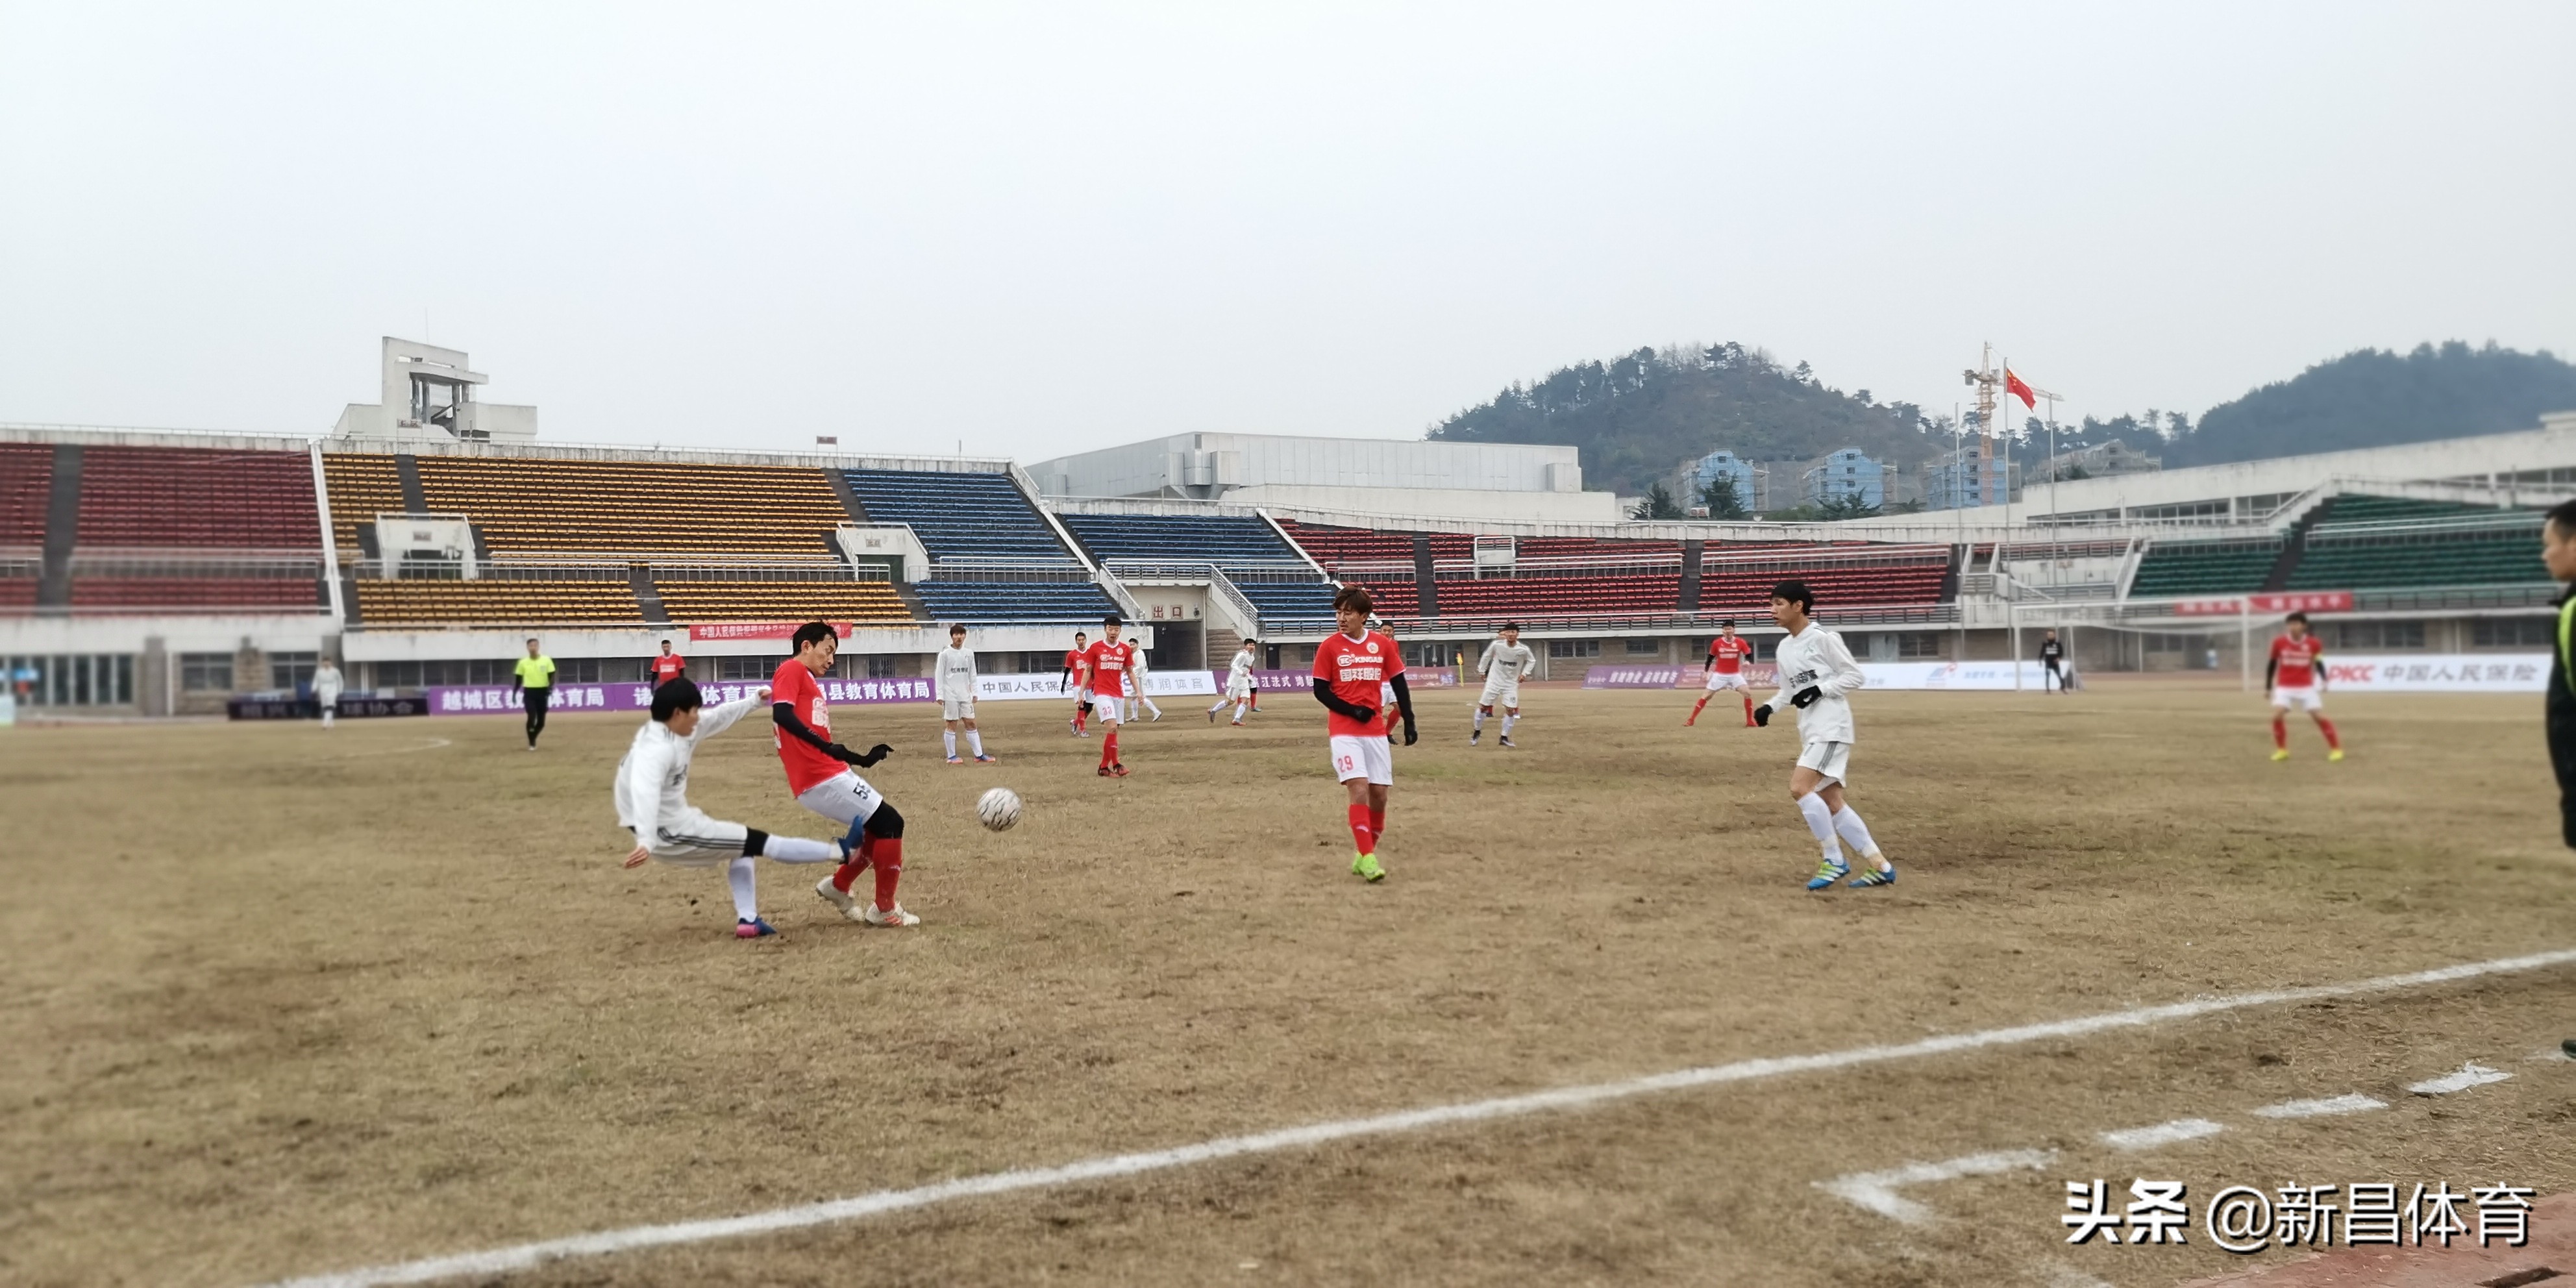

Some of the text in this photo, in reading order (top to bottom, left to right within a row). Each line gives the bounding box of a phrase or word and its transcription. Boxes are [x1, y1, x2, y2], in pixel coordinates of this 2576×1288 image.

[1154, 605, 1182, 619] 出口
[2383, 663, 2537, 682] 中国人民保险
[443, 687, 604, 711] 越城区教体育局
[1337, 755, 1354, 773] 29
